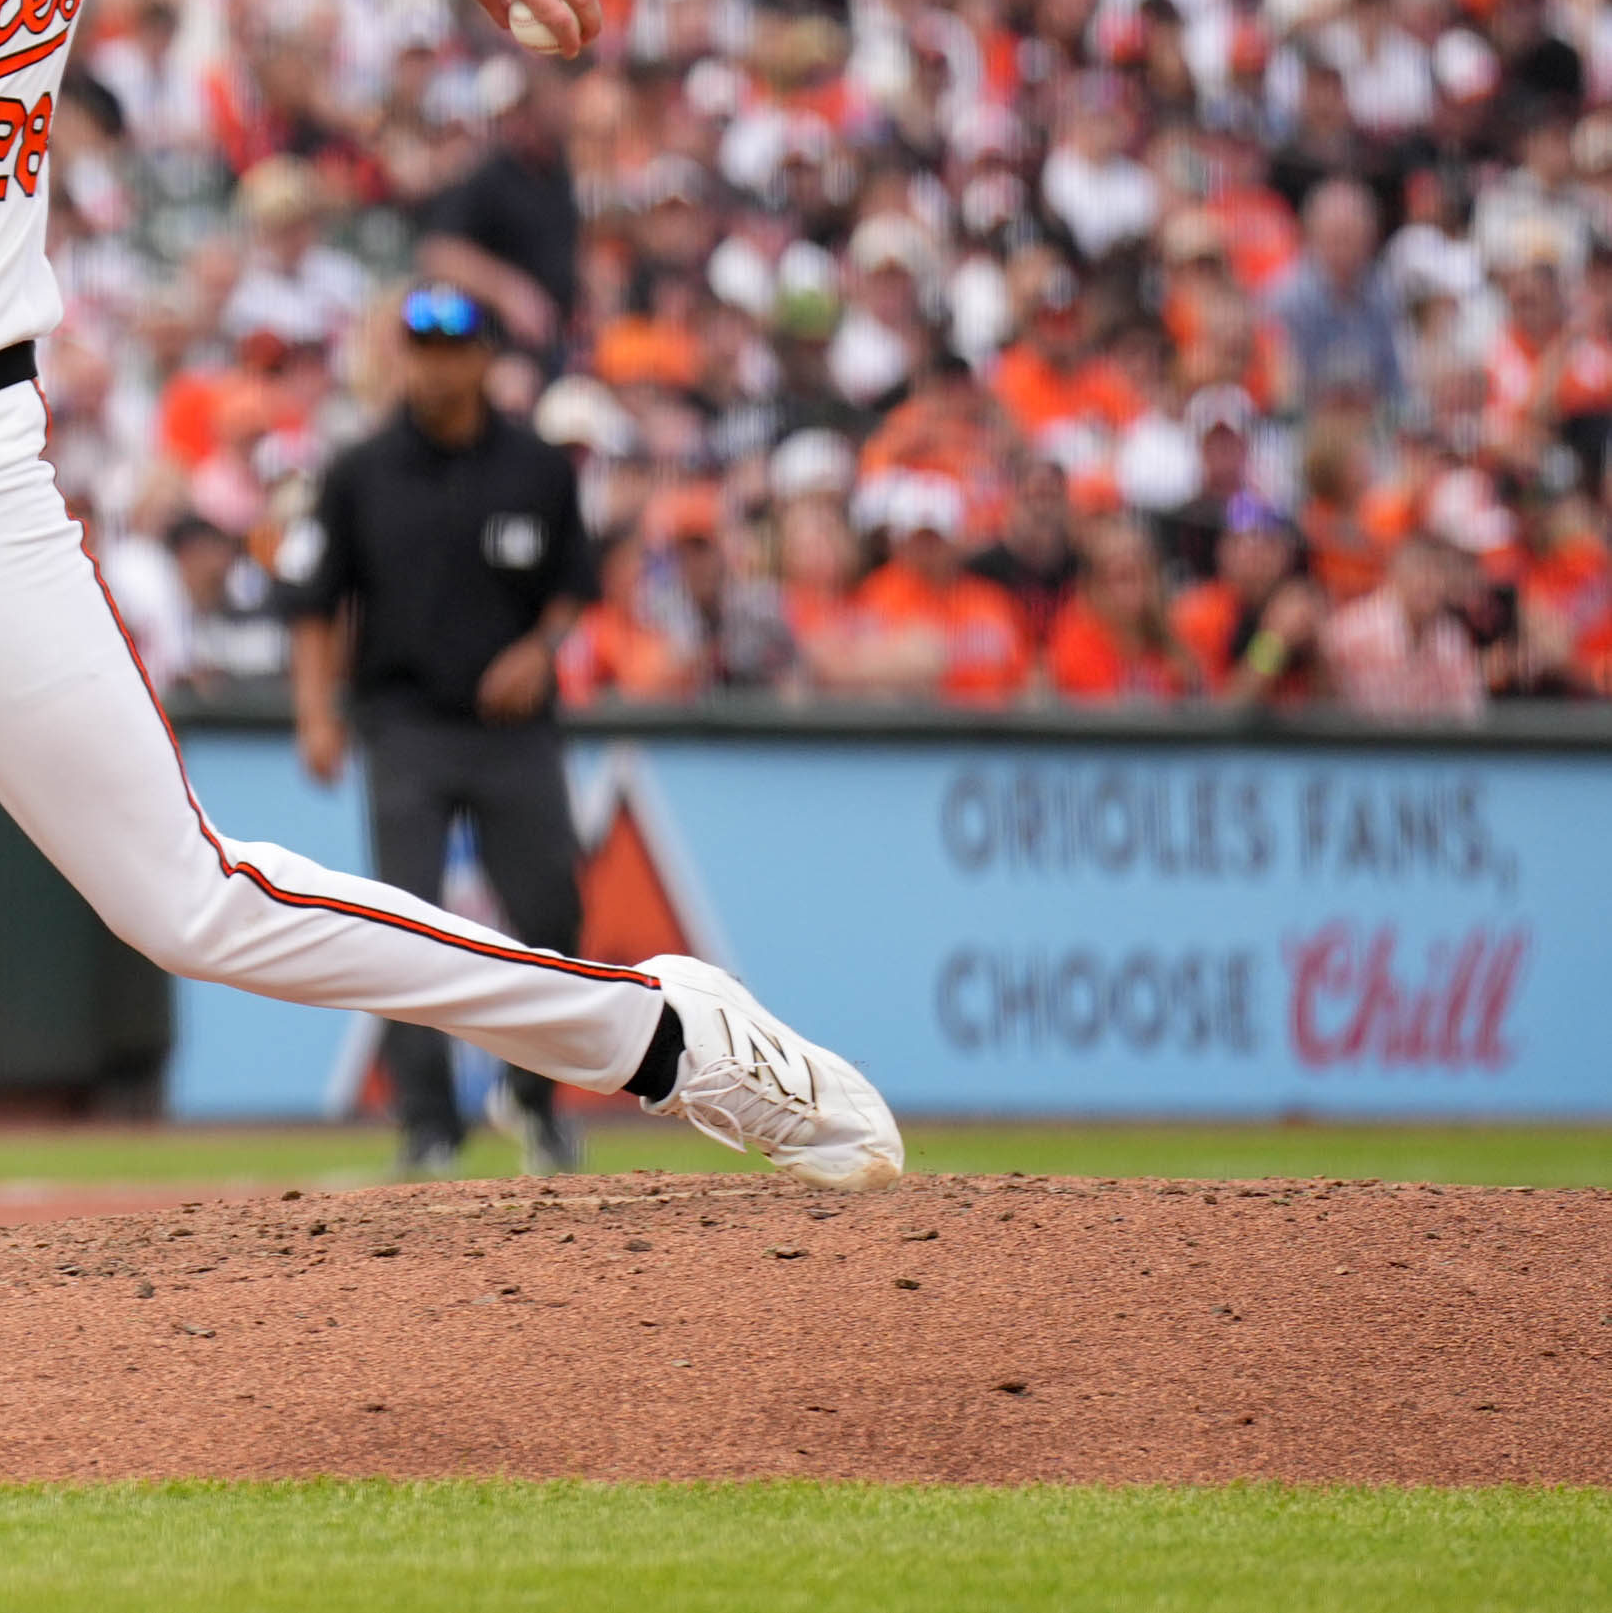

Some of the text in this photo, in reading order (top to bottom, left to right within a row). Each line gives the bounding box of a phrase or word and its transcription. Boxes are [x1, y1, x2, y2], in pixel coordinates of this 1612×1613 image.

[940, 767, 1272, 875] ORIOLES
[935, 916, 1530, 1075] CHOOSE Chill
